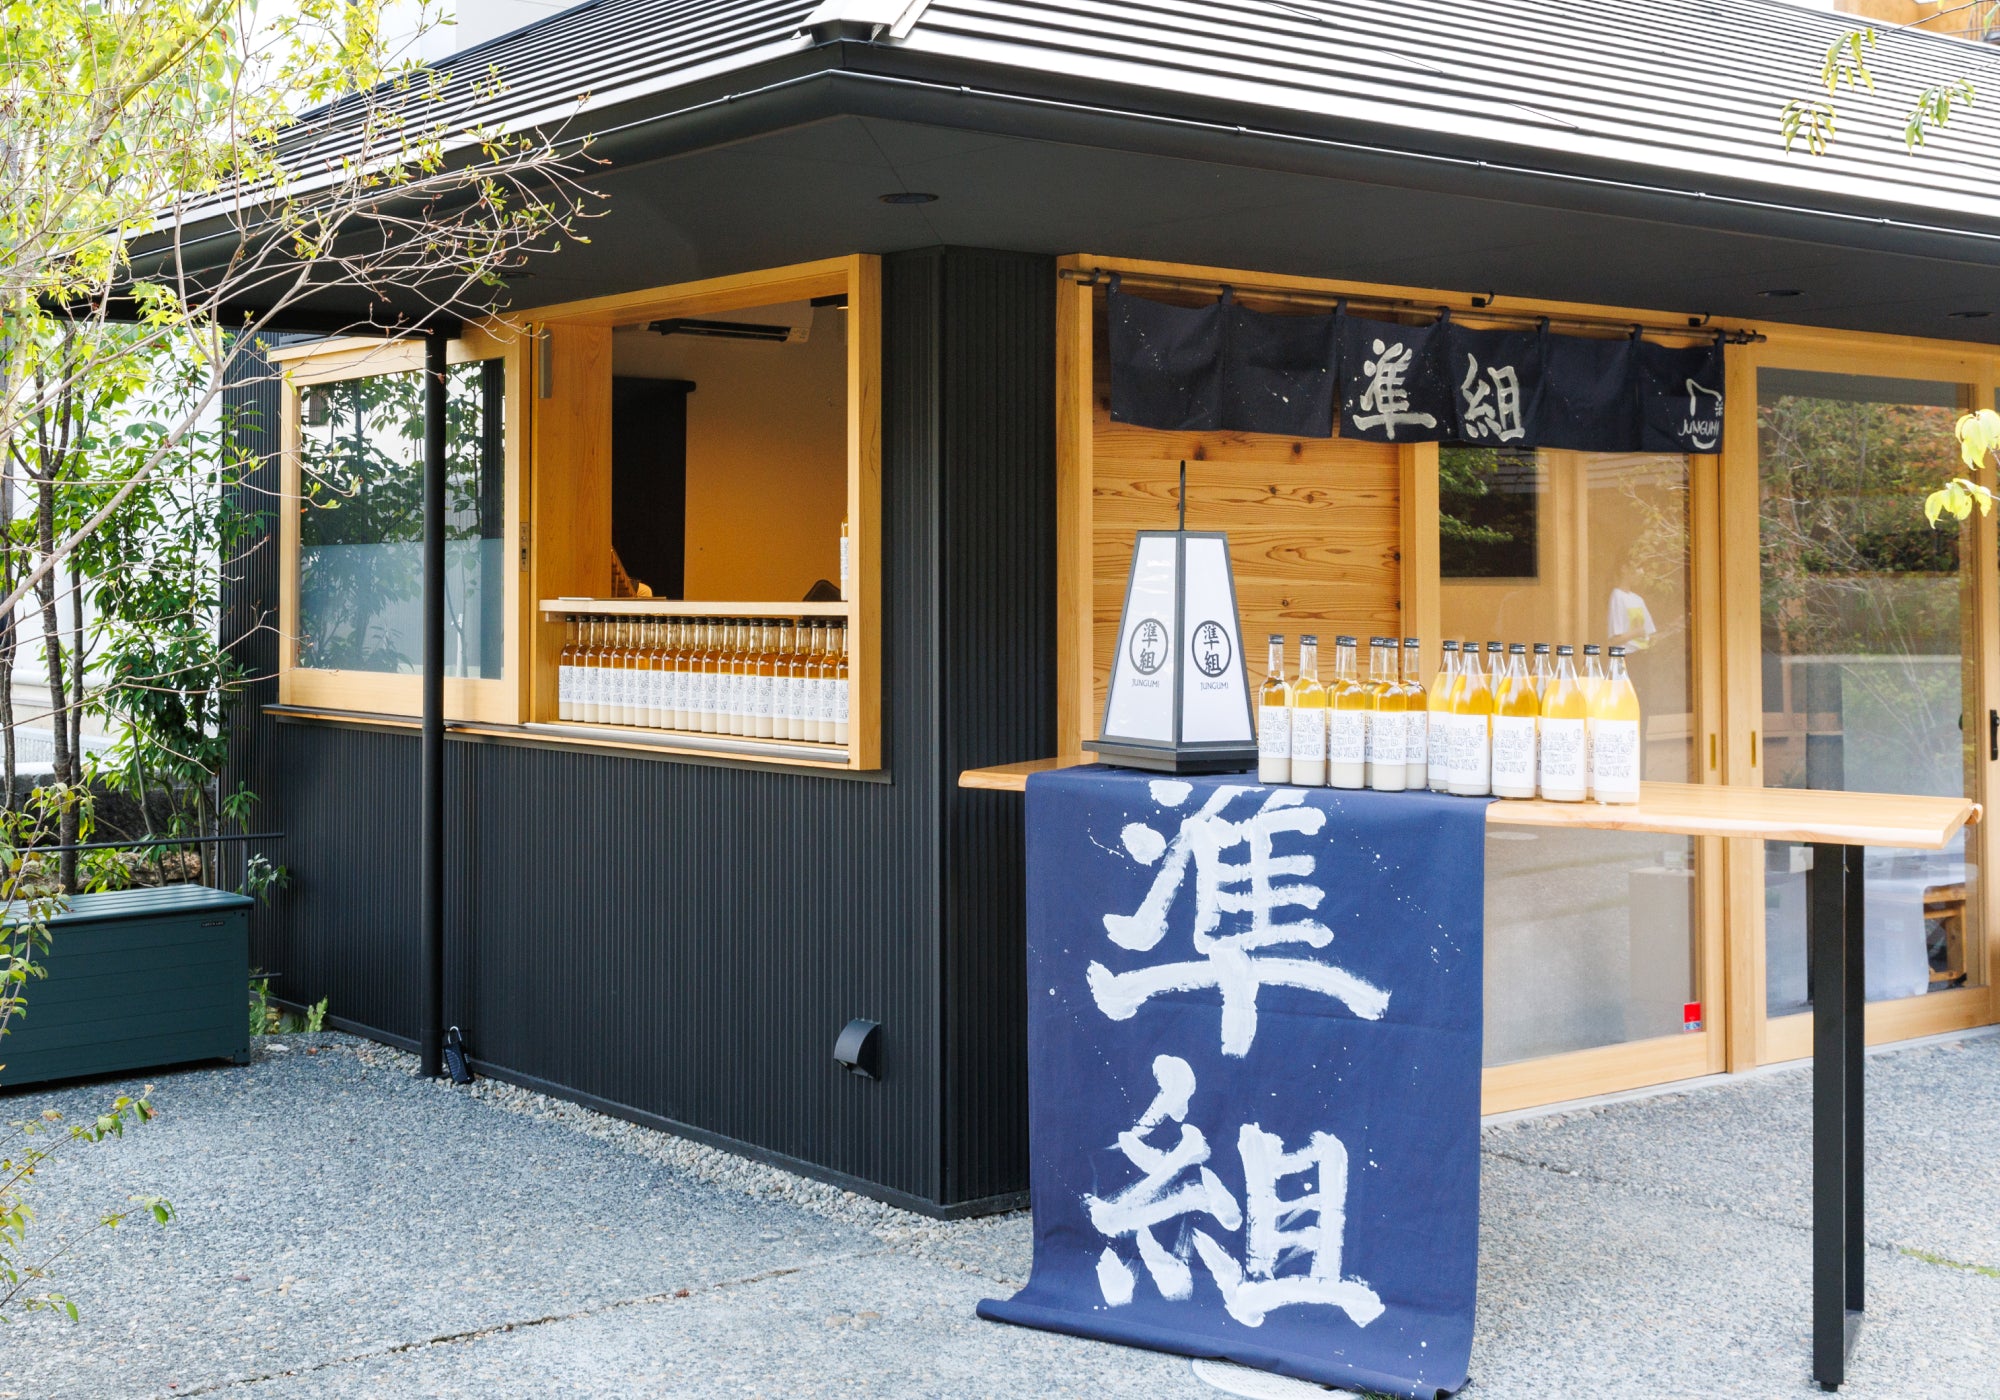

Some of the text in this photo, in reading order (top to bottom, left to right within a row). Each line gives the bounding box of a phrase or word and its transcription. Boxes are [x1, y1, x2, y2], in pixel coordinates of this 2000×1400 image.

[1352, 338, 1526, 442] 準組
[1138, 622, 1158, 671] 準組
[1203, 624, 1222, 673] 準組
[1131, 678, 1160, 689] JUNGUMI
[1200, 681, 1229, 691] JUNGUMI
[1082, 779, 1392, 1328] 準組
